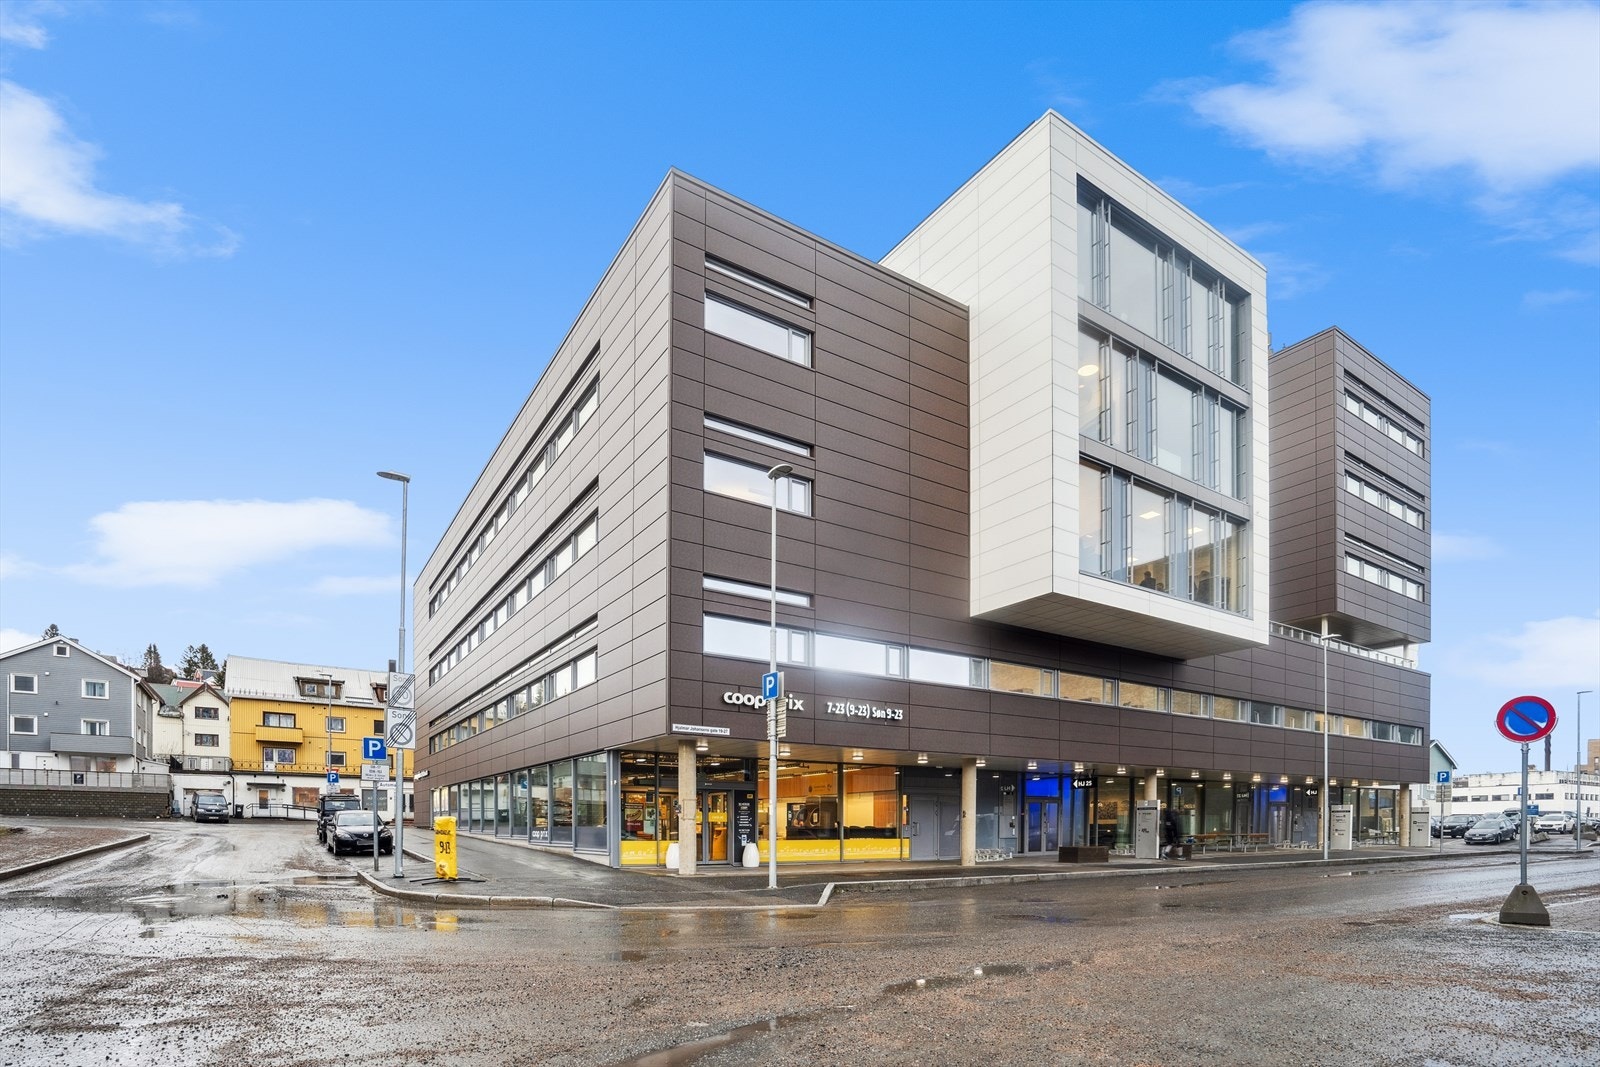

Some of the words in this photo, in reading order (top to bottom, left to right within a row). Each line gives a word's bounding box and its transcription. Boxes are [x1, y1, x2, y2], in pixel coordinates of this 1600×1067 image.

[766, 676, 775, 696] P
[723, 691, 767, 709] coop
[827, 702, 845, 714] 7-23
[846, 702, 870, 719] (9-23)
[872, 707, 886, 719] Søn
[886, 708, 903, 720] 9-23
[369, 740, 381, 756] P
[330, 774, 337, 782] P
[1440, 772, 1447, 781] P
